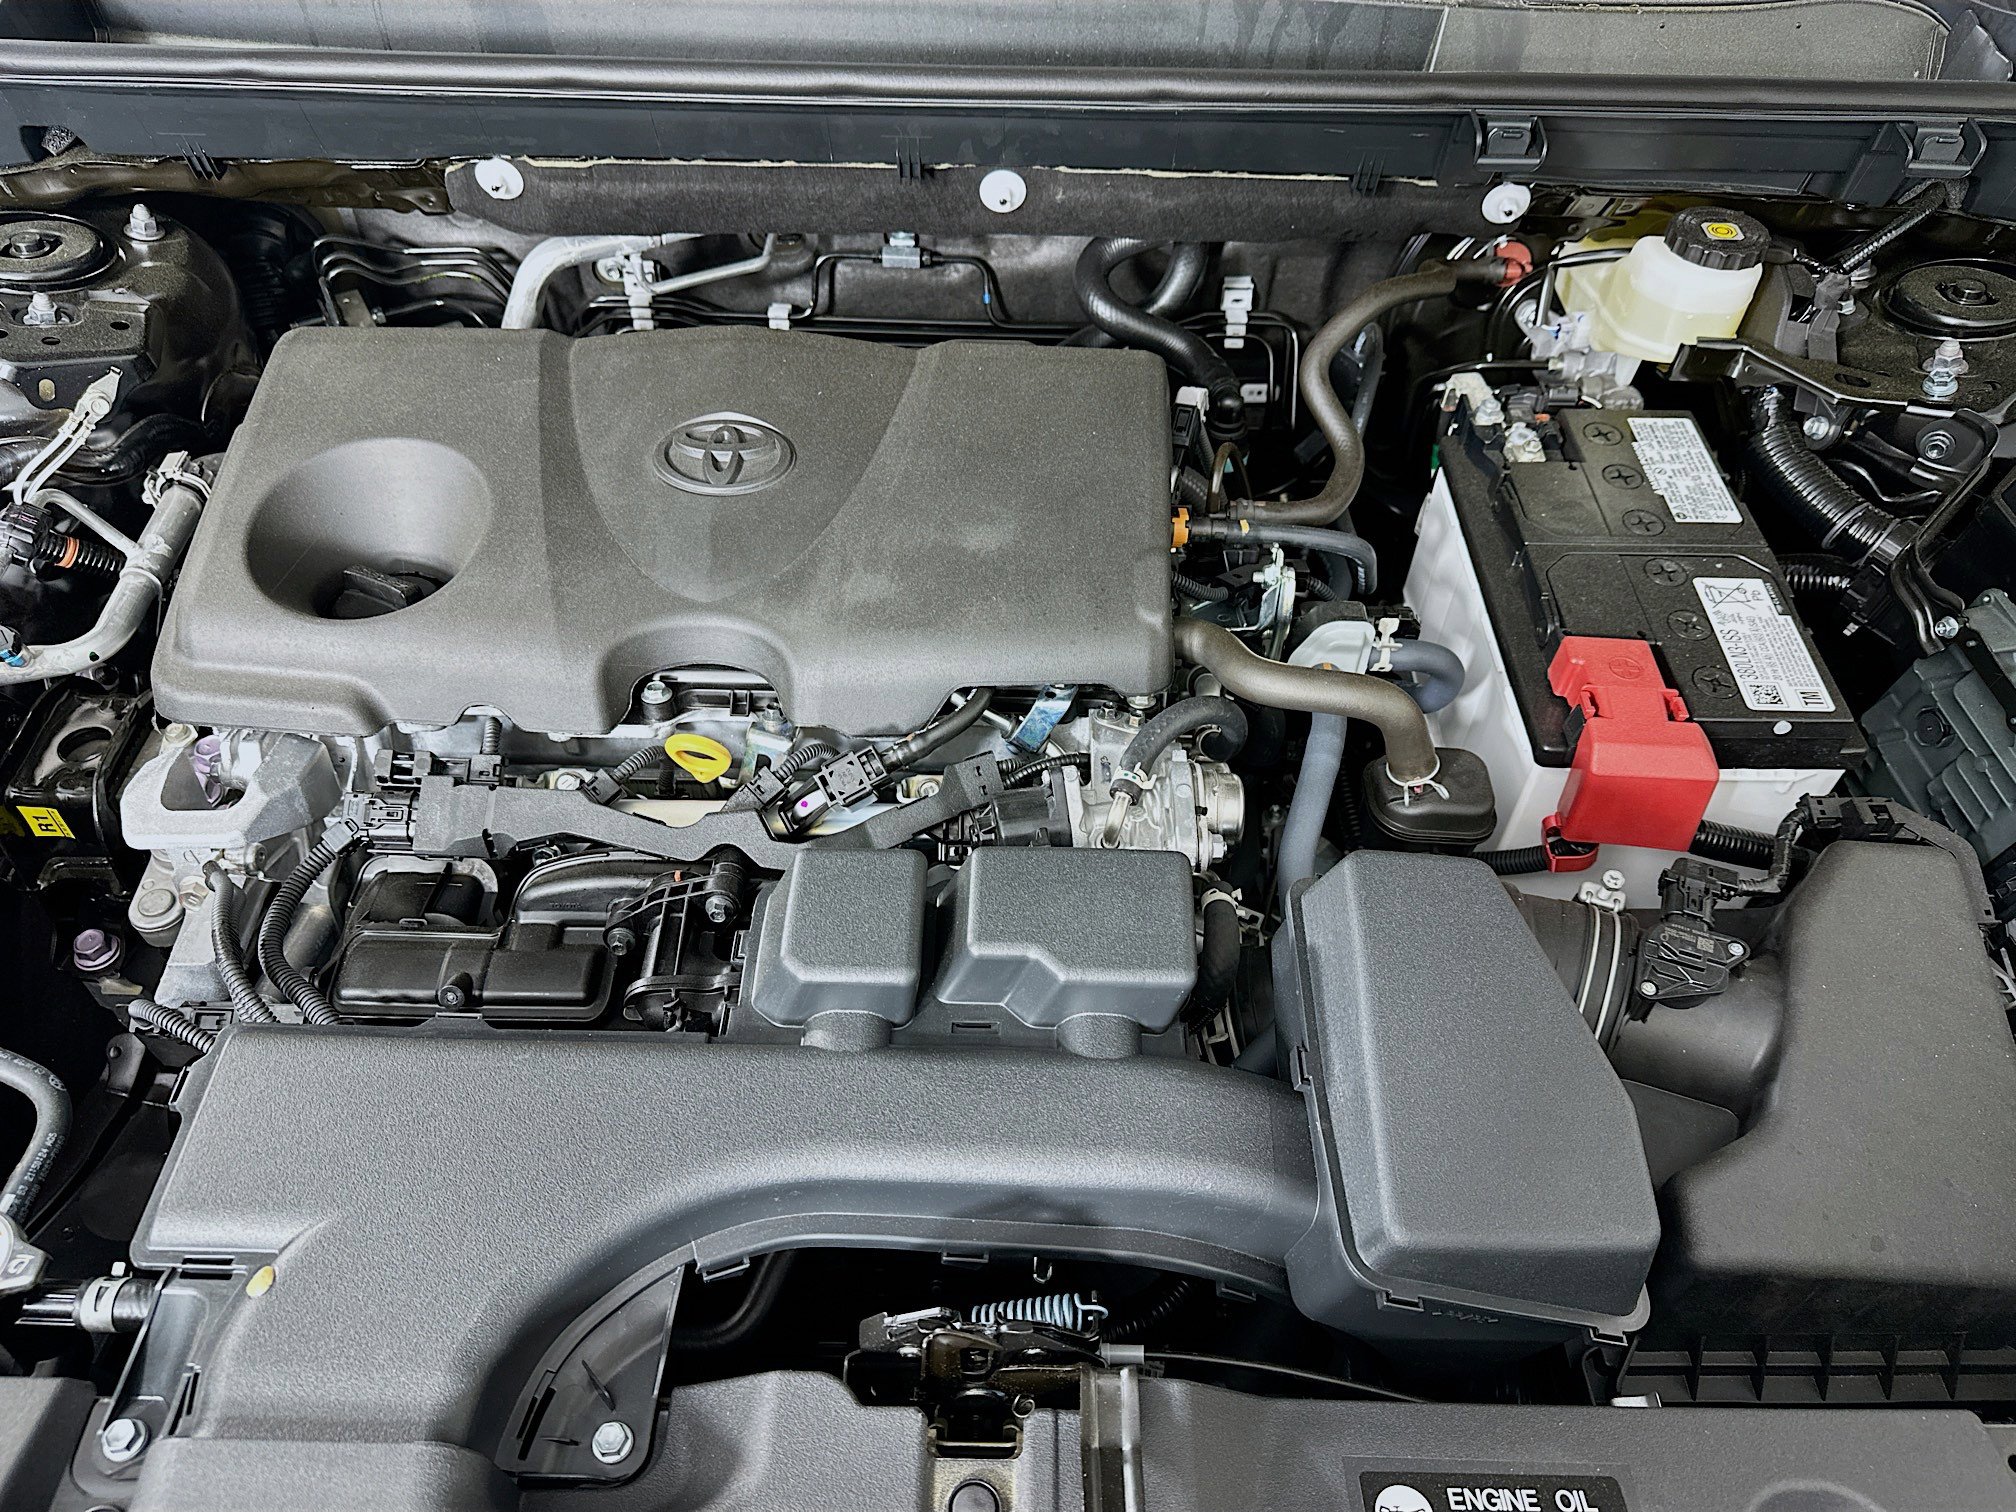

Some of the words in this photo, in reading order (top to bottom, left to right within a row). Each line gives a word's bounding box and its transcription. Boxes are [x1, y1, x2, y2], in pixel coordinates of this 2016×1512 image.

[1800, 691, 1825, 706] TM
[32, 815, 57, 833] R1
[1446, 1487, 1541, 1512] ENGINE
[1554, 1489, 1599, 1512] OIL
